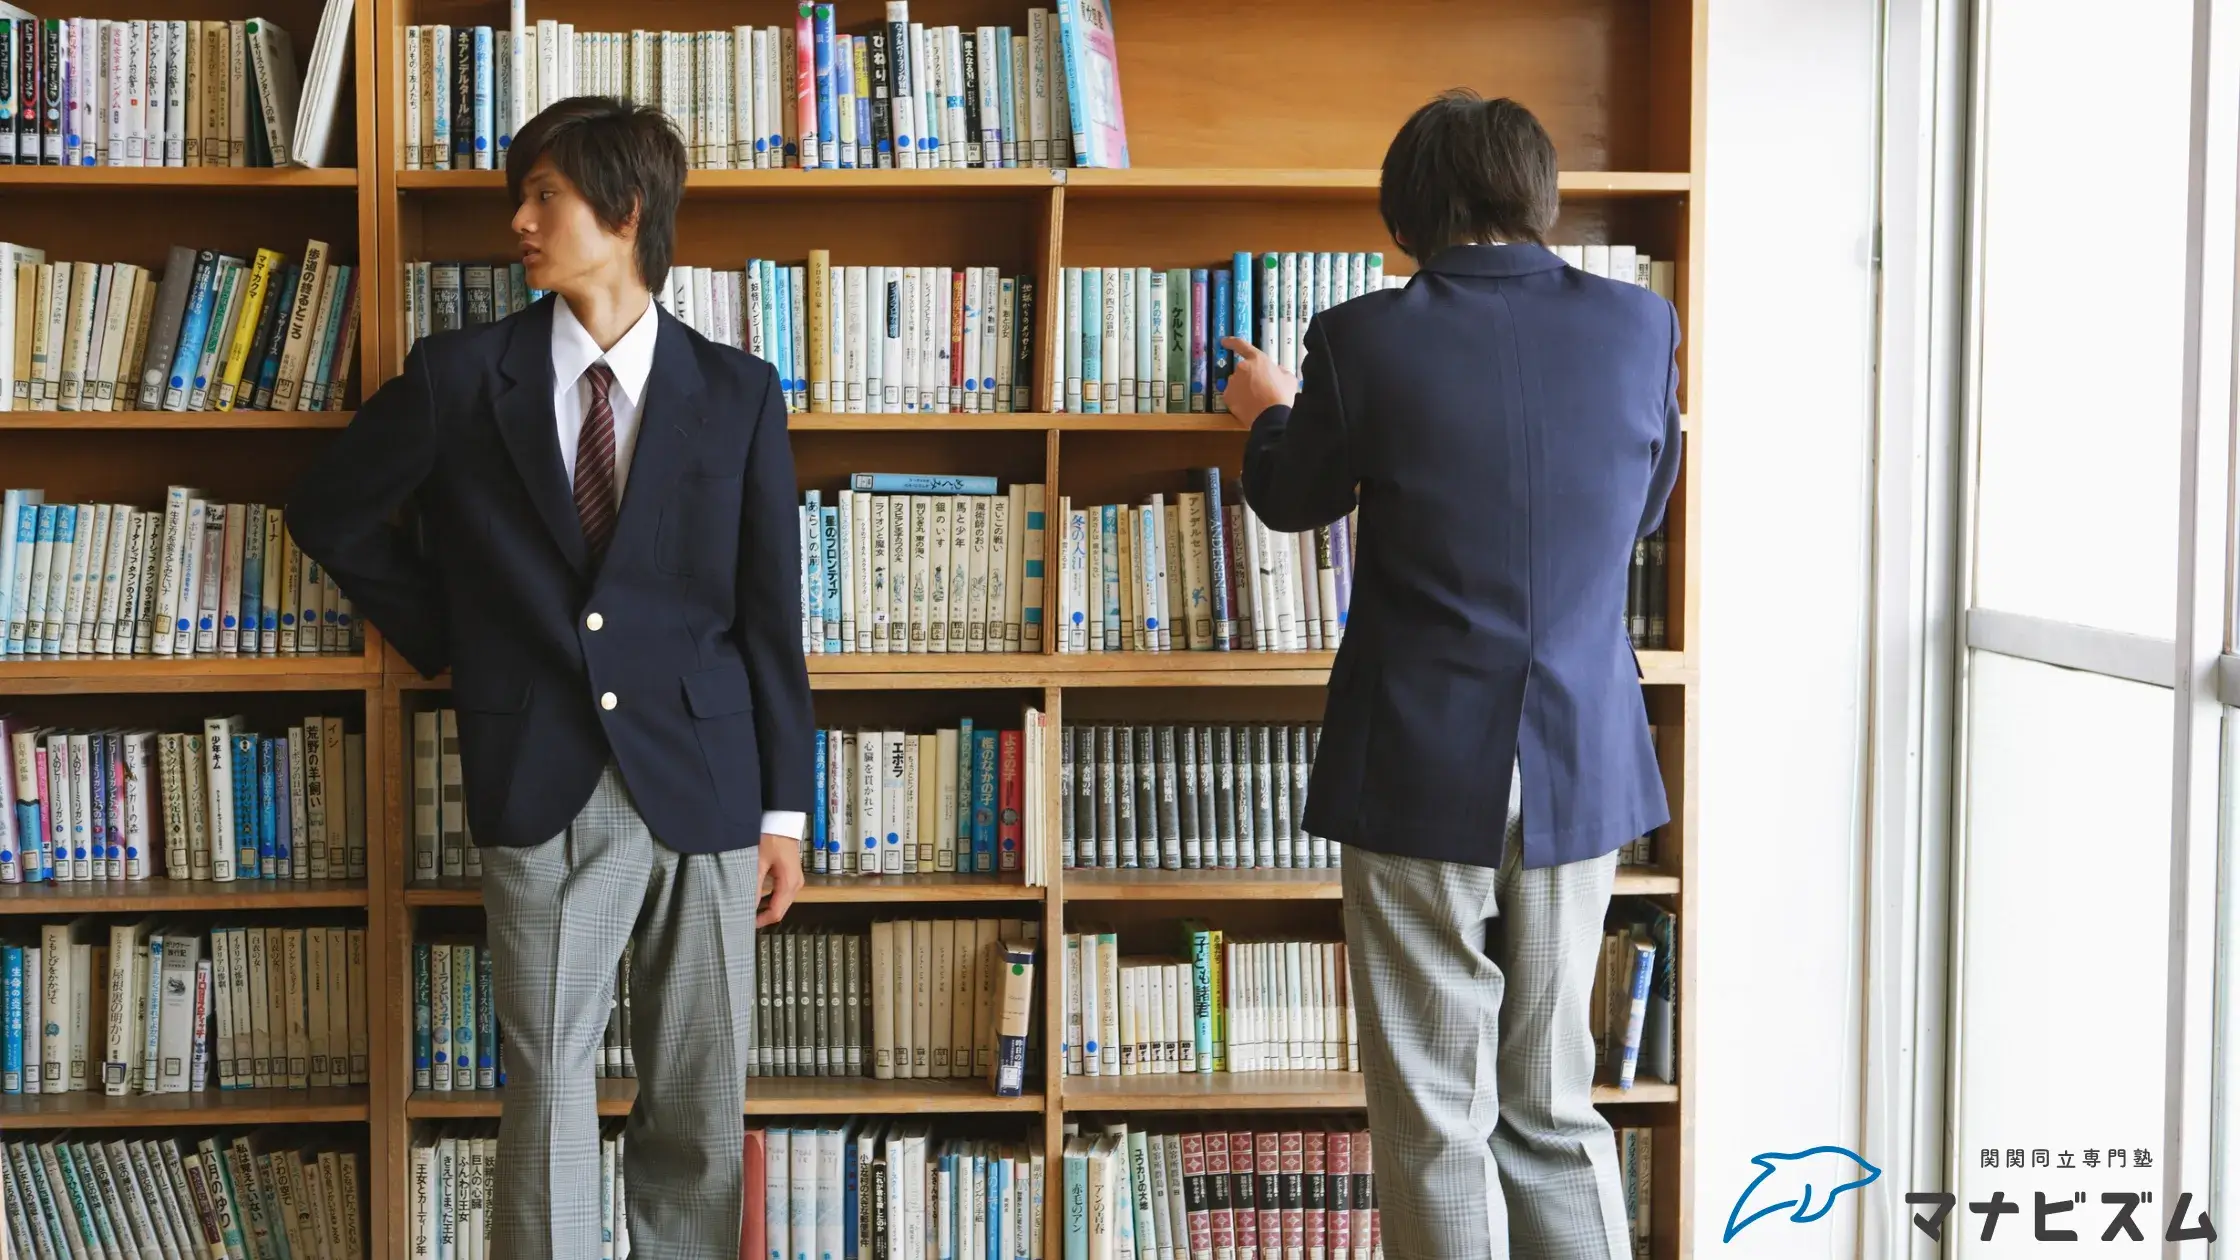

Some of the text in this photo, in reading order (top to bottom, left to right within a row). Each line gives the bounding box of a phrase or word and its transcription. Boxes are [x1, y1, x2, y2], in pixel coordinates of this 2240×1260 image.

[458, 31, 470, 114] ネアンデルタール
[1021, 283, 1033, 361] 地球からのメッセージ
[1106, 273, 1115, 339] 父への四つの質問
[1171, 307, 1184, 352] ケルト人
[269, 514, 279, 542] レーナ
[808, 500, 820, 567] あらしの前
[875, 502, 885, 557] ライオンと魔女
[935, 502, 946, 548] 銀のいす
[955, 502, 966, 549] 馬と少年
[974, 502, 986, 553] 魔術師のおい
[993, 502, 1005, 553] さいごの戦い
[1188, 497, 1202, 558] アンデルセン
[1211, 518, 1225, 593] ANDERSEN
[825, 515, 839, 600] 星のフロンティア
[211, 735, 222, 770] 少年キム
[305, 725, 322, 808] 荒野の羊飼い
[327, 723, 338, 748] イシ
[892, 742, 904, 778] エボラ
[1003, 733, 1017, 781] よその子
[864, 741, 874, 817] 心臓を貫かれて
[981, 736, 995, 806] 檻のなかの子
[47, 933, 60, 1006] ともしびをかかげて
[165, 940, 192, 948] ガリヴァー
[167, 949, 187, 957] 旅行記
[110, 968, 125, 1046] 屋根裏の明かり
[438, 951, 449, 1026] シーラという子
[203, 1147, 231, 1229] 六月のゆり
[236, 1144, 264, 1222] 私は覚えていない
[416, 1164, 428, 1256] 王女とカーディー少年
[442, 1156, 453, 1245] きえてしまった王女
[458, 1156, 470, 1223] ふんわり王女
[471, 1154, 482, 1209] 巨人の心臓
[1071, 1183, 1083, 1233] 赤毛のアン
[1134, 1148, 1149, 1211] ユウカリの大地
